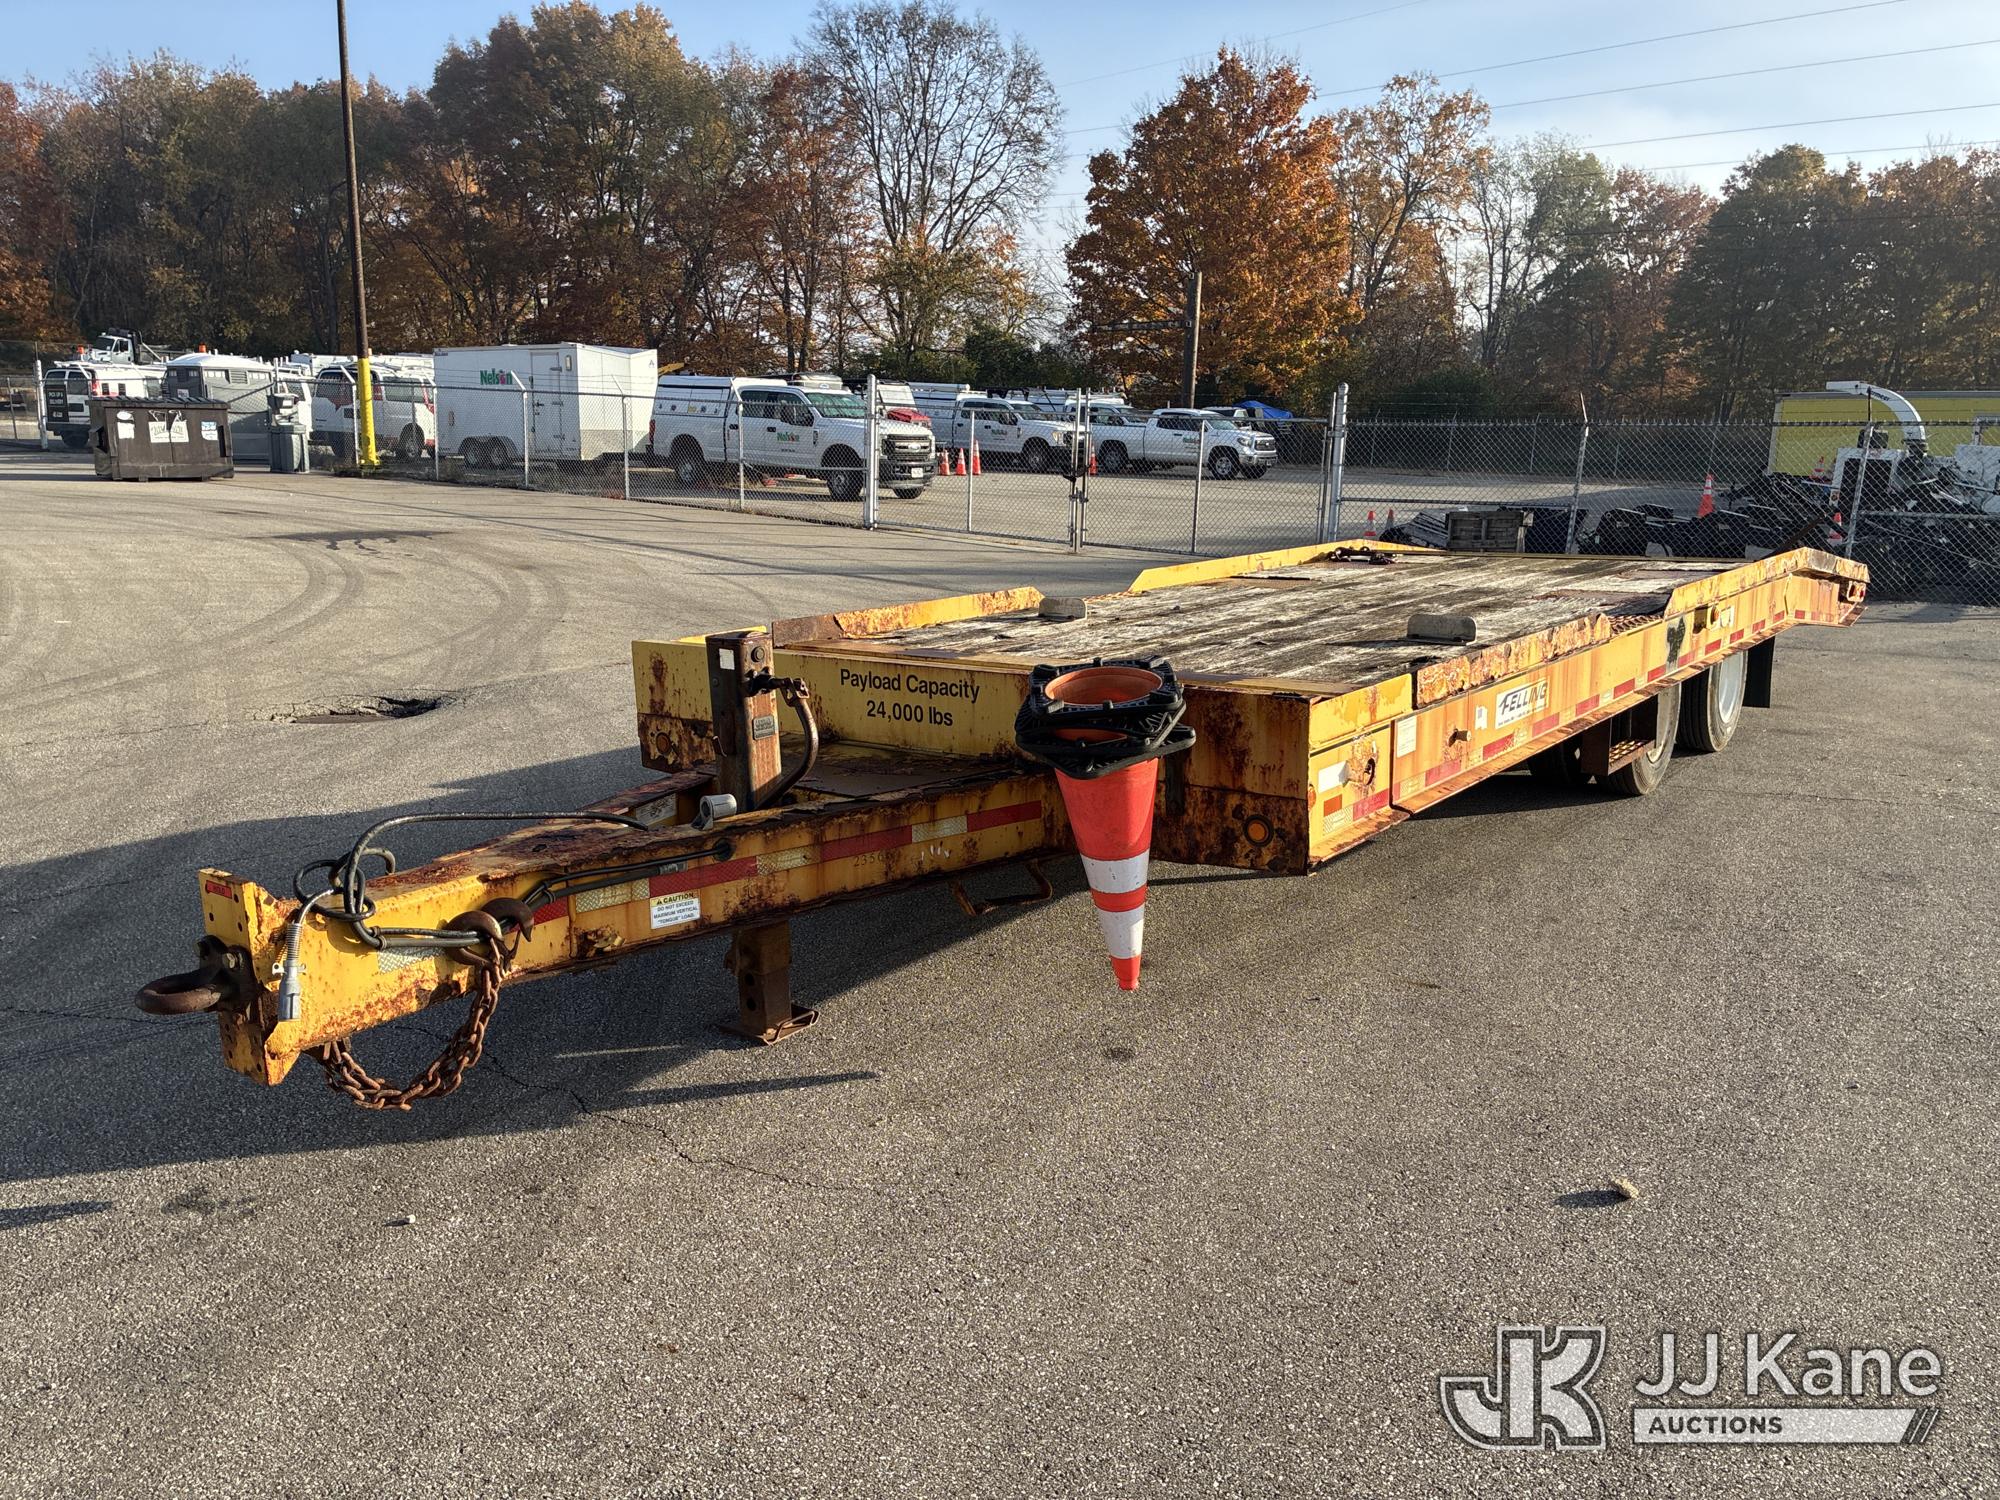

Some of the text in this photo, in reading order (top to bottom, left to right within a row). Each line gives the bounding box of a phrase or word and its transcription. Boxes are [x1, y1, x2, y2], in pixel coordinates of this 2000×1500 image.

[480, 368, 513, 385] Nelson
[840, 669, 980, 704] Payload Capacity
[1498, 682, 1547, 715] FELLING
[866, 700, 953, 726] 24,000 lbs
[663, 892, 694, 903] CAUTION
